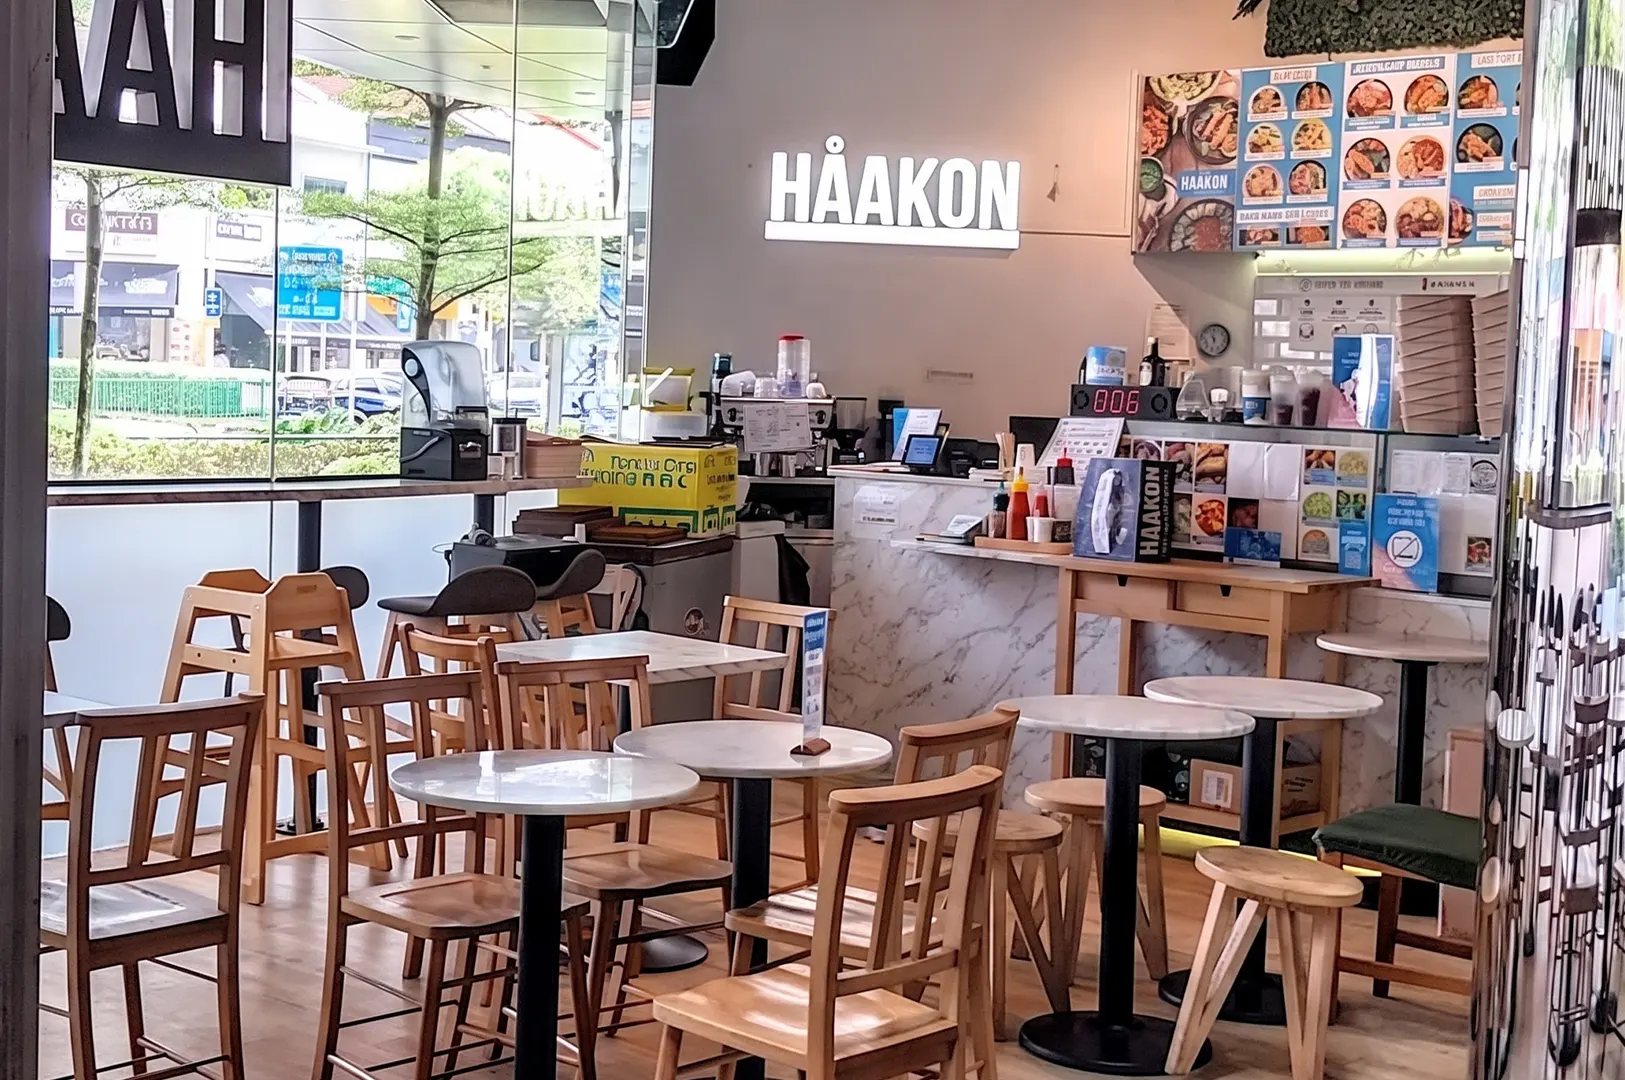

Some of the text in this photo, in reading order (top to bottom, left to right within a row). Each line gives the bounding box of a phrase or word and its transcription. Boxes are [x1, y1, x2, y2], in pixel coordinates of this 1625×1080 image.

[770, 134, 1021, 231] HÅAKON
[1181, 174, 1228, 190] HAAKON
[1093, 389, 1140, 414] 006
[1139, 466, 1161, 555] HAAKON
